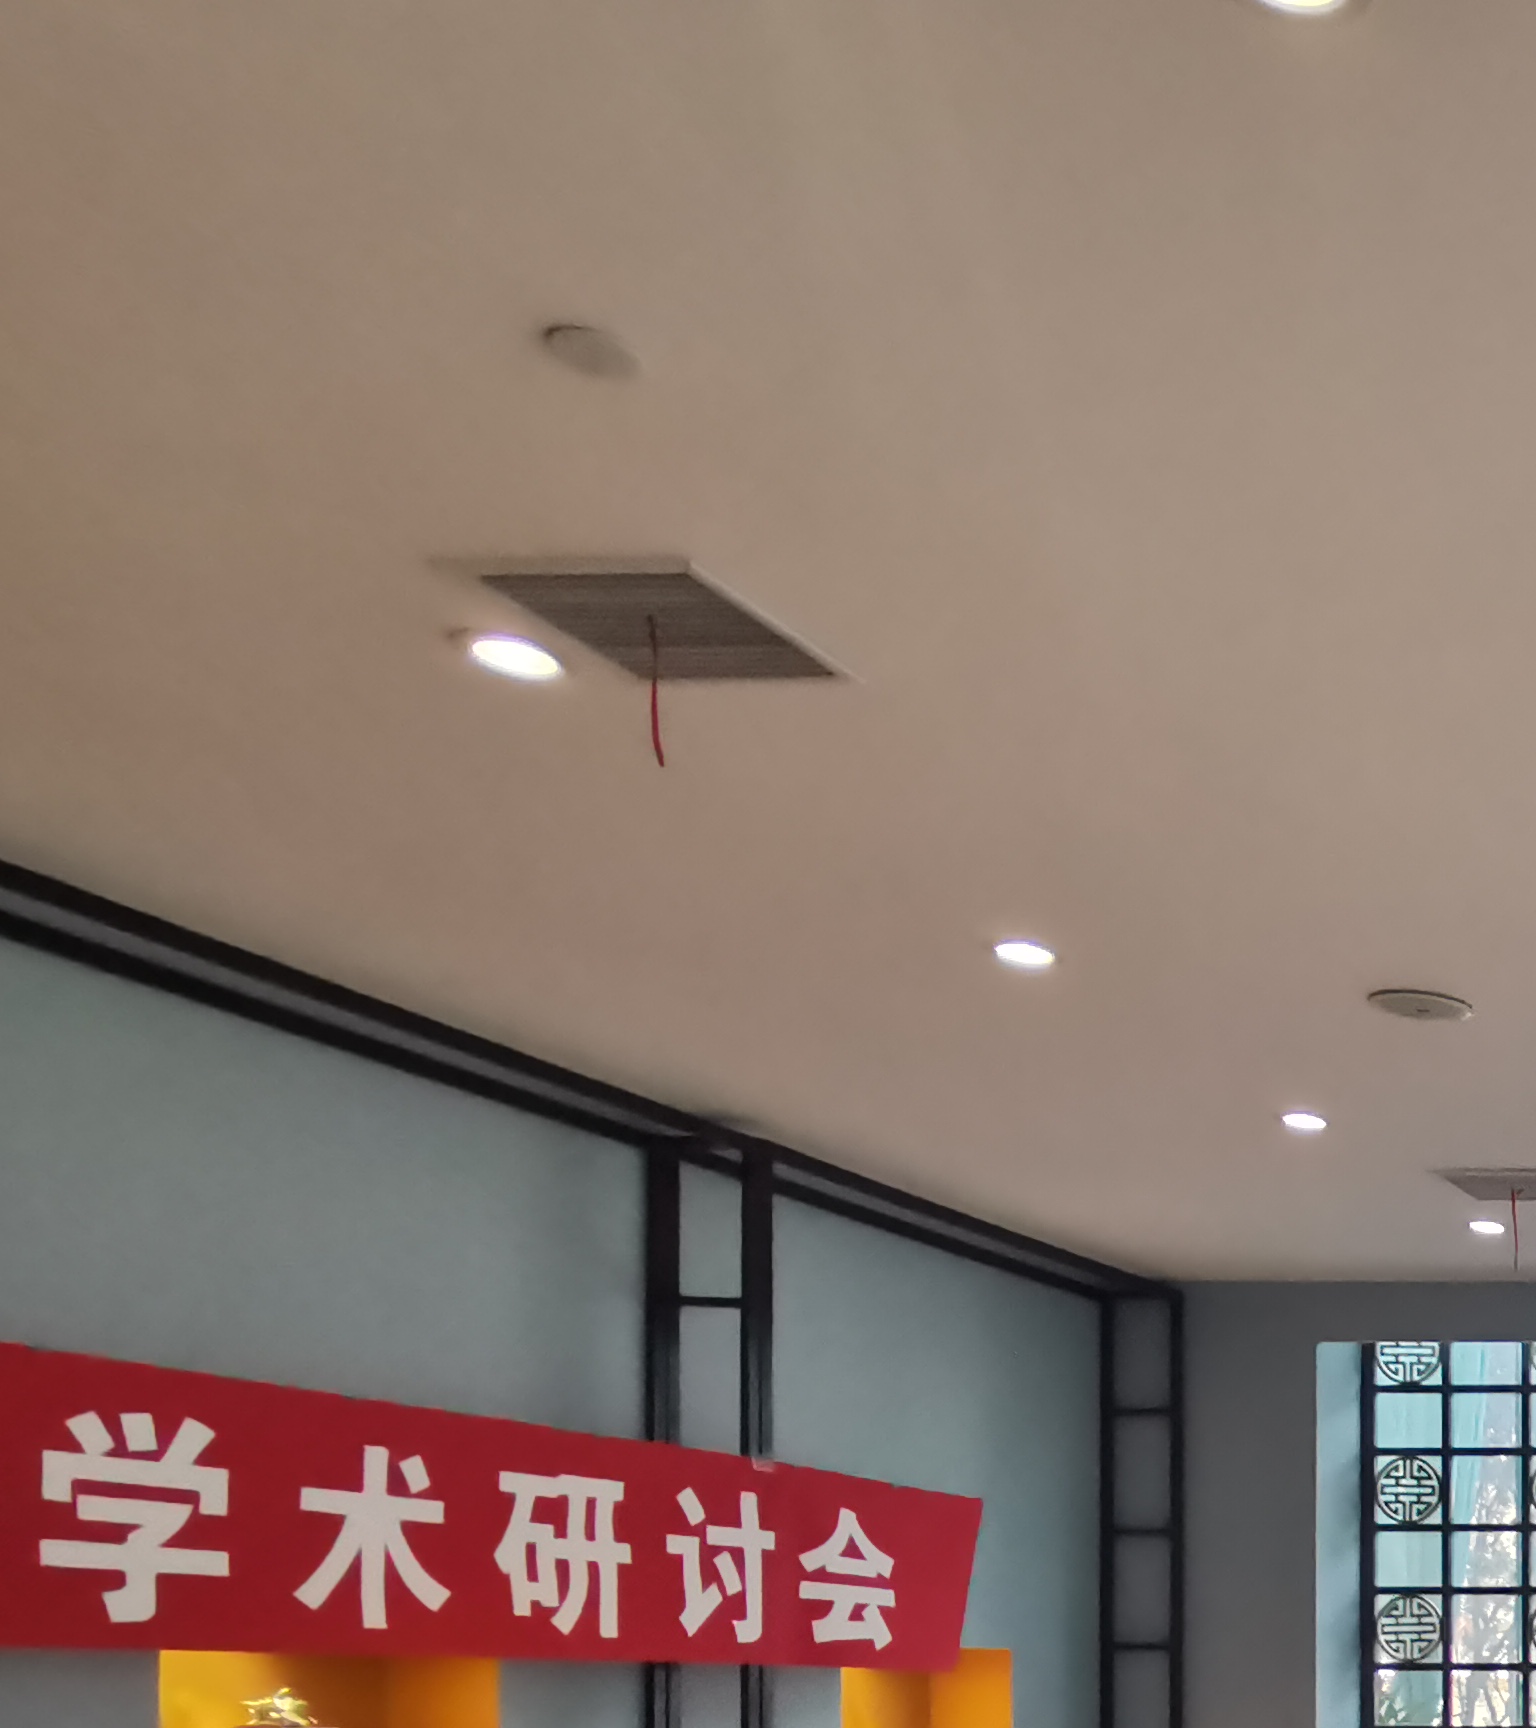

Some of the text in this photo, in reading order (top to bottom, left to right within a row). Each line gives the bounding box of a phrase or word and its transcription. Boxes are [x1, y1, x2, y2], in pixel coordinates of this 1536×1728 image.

[39, 1410, 896, 1651] 学术研讨会
